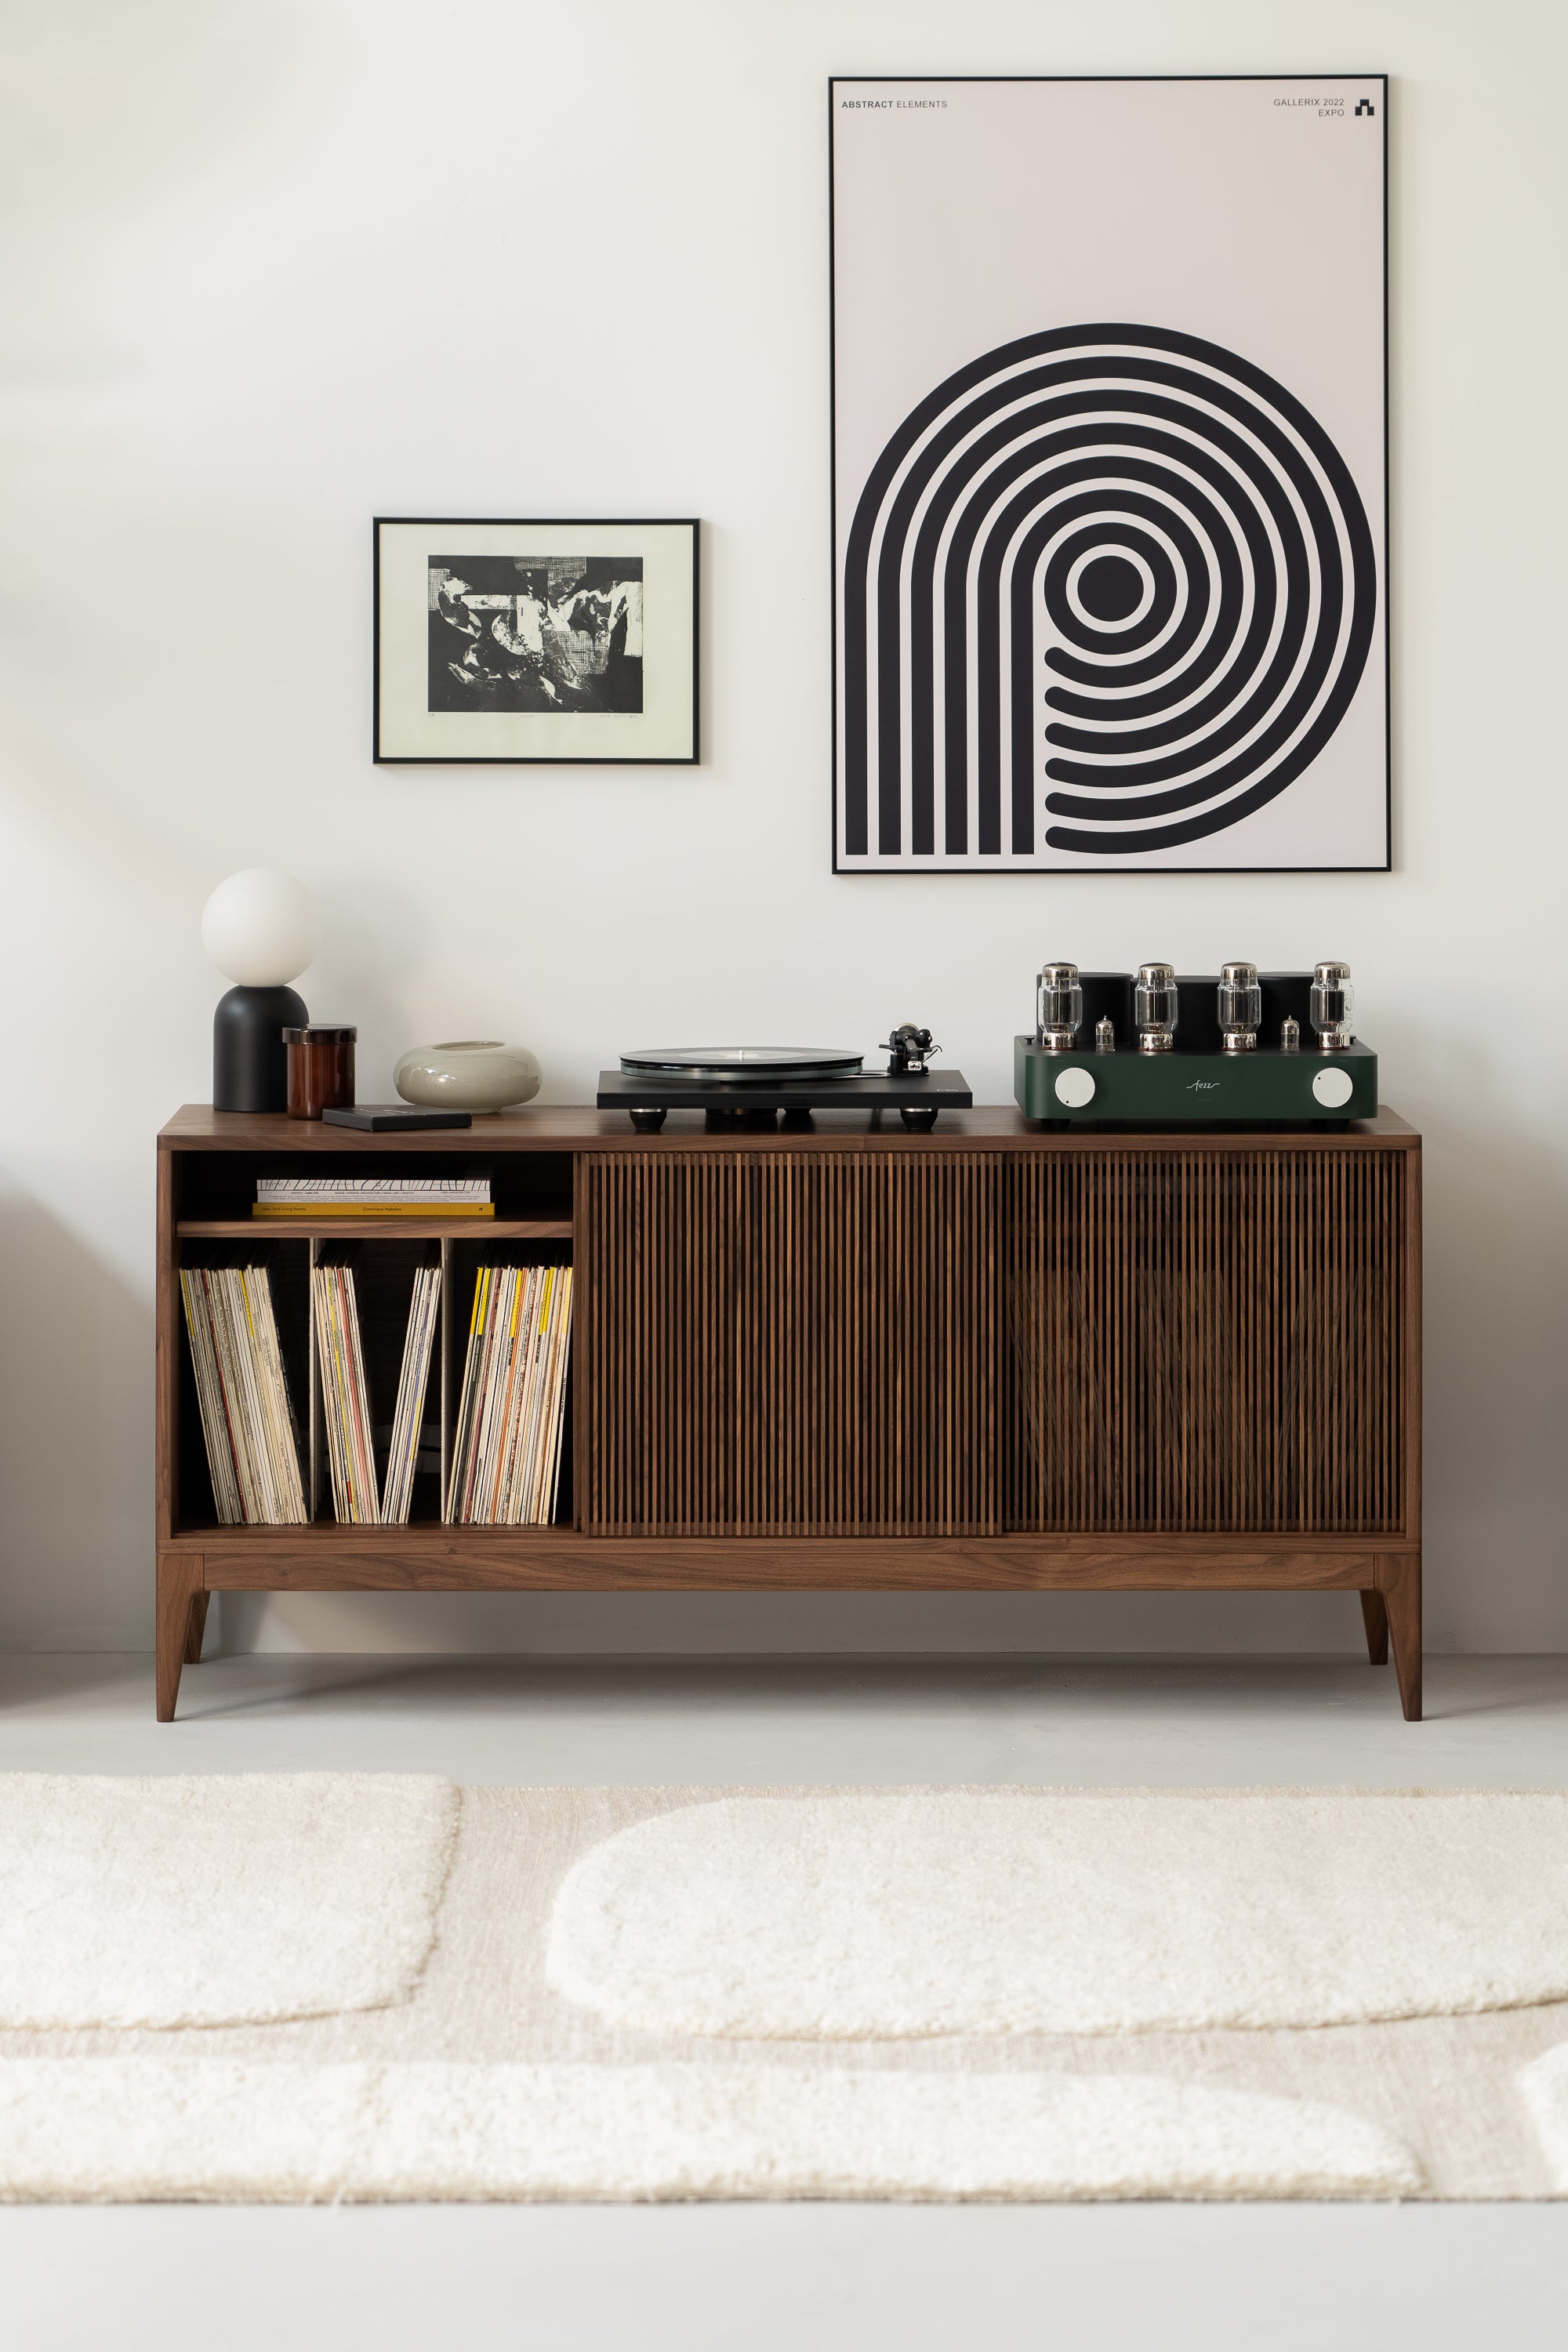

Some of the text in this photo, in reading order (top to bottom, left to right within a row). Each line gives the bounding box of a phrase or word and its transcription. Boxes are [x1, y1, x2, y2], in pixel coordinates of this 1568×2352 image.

[1273, 98, 1345, 107] GALLERIX 2022
[1318, 108, 1345, 117] EXPO
[1186, 1080, 1220, 1091] fezz
